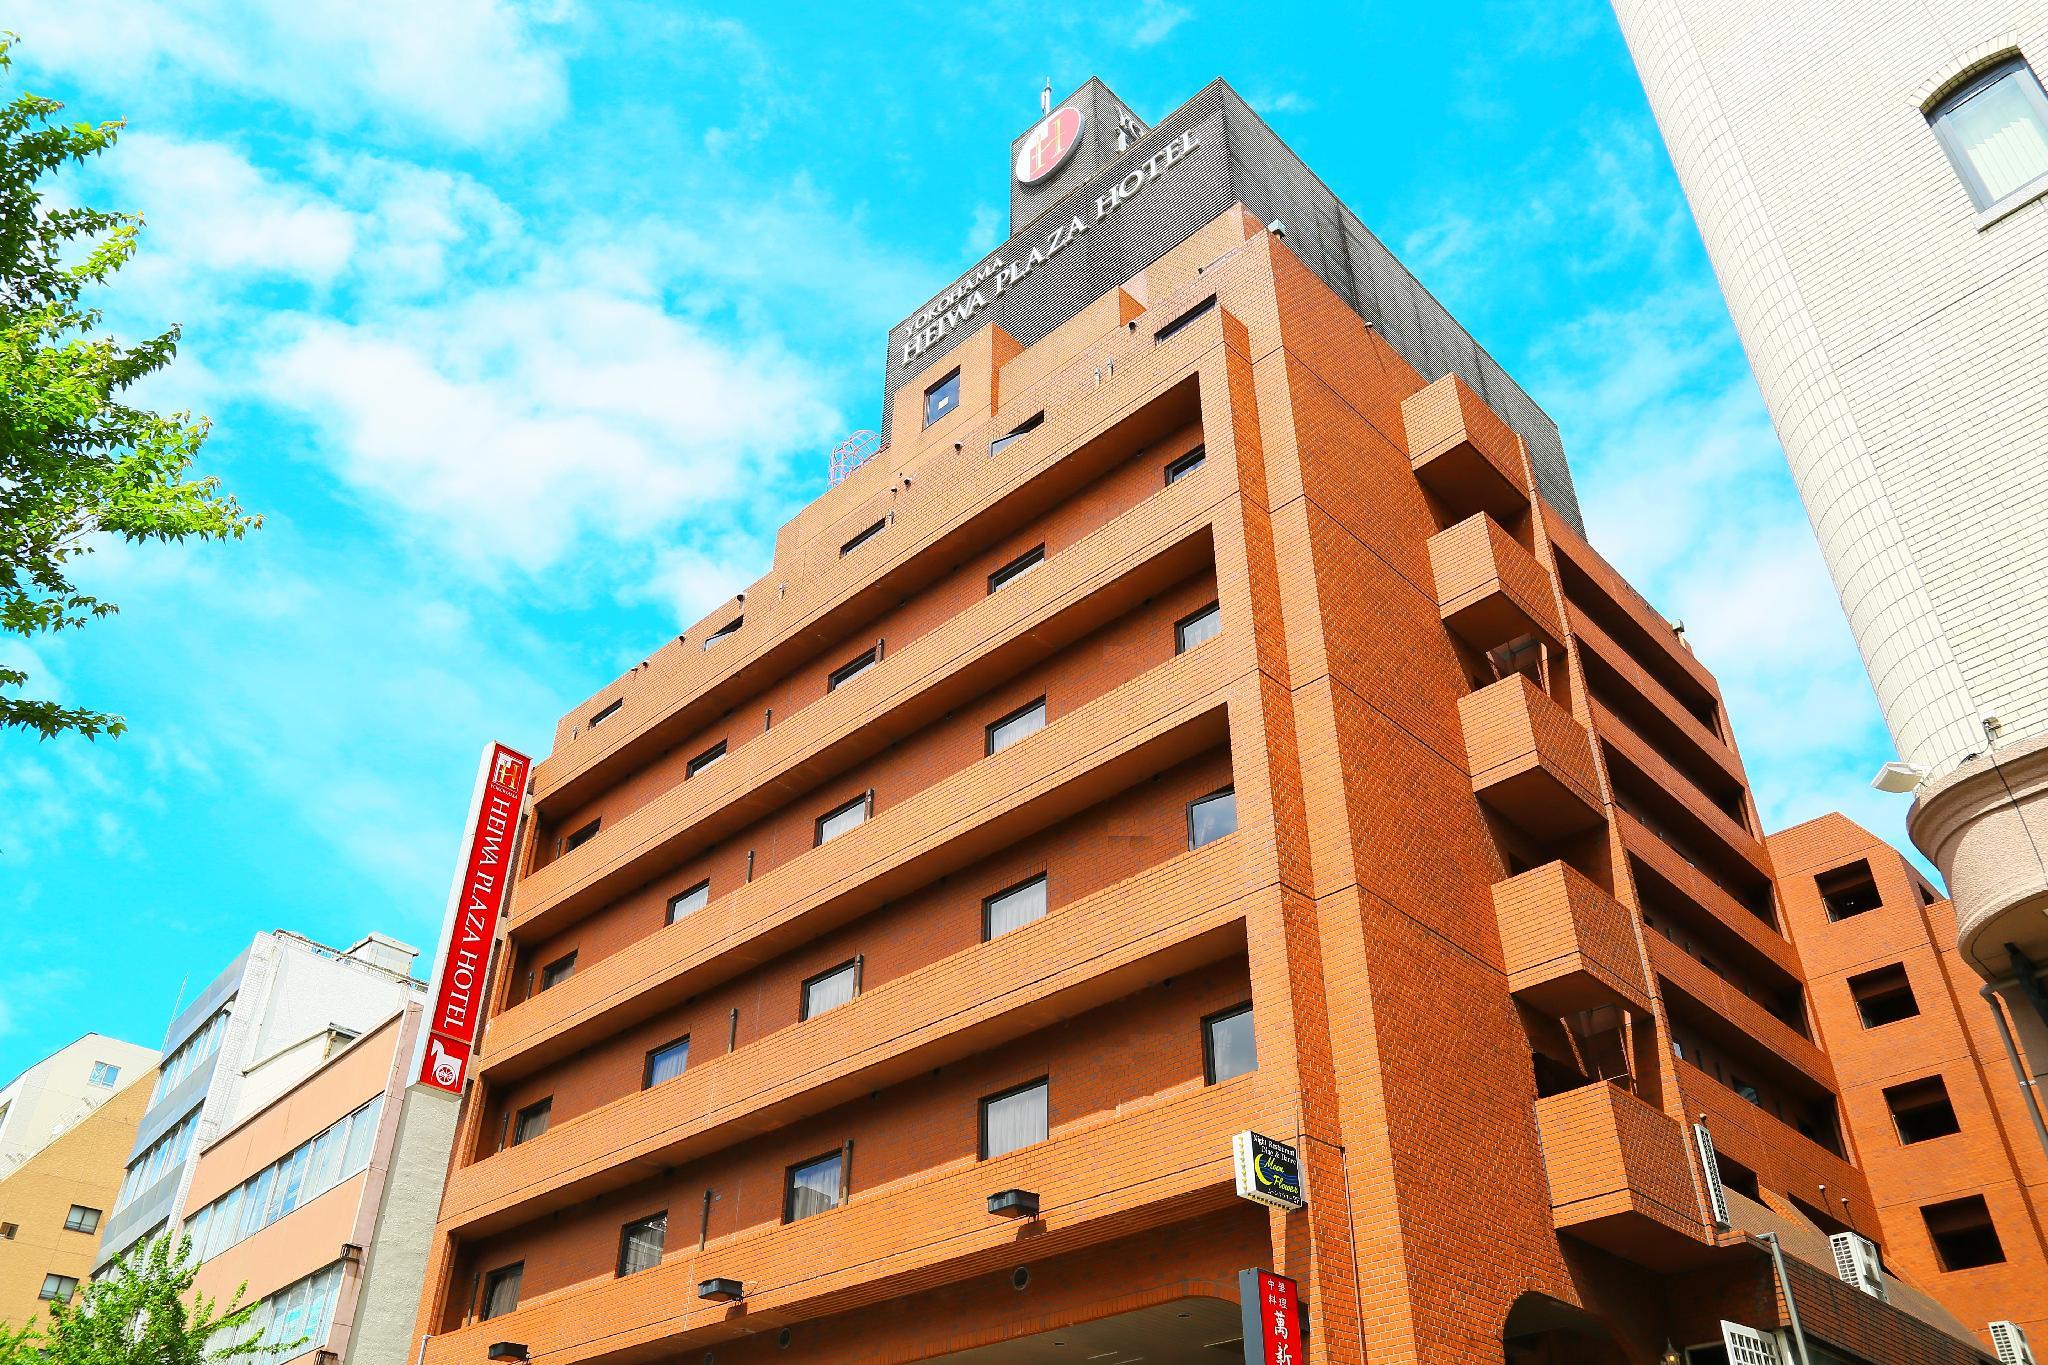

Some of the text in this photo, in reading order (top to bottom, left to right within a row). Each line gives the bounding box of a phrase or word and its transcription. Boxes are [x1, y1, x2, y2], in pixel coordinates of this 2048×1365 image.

[902, 128, 1201, 368] HEIWA PLAZA HOTEL
[905, 257, 1005, 337] YOKOHAMA
[443, 796, 511, 1029] HEIWA PLAZA HOTEL
[1263, 1157, 1285, 1174] Moon
[1273, 1175, 1299, 1194] Flower
